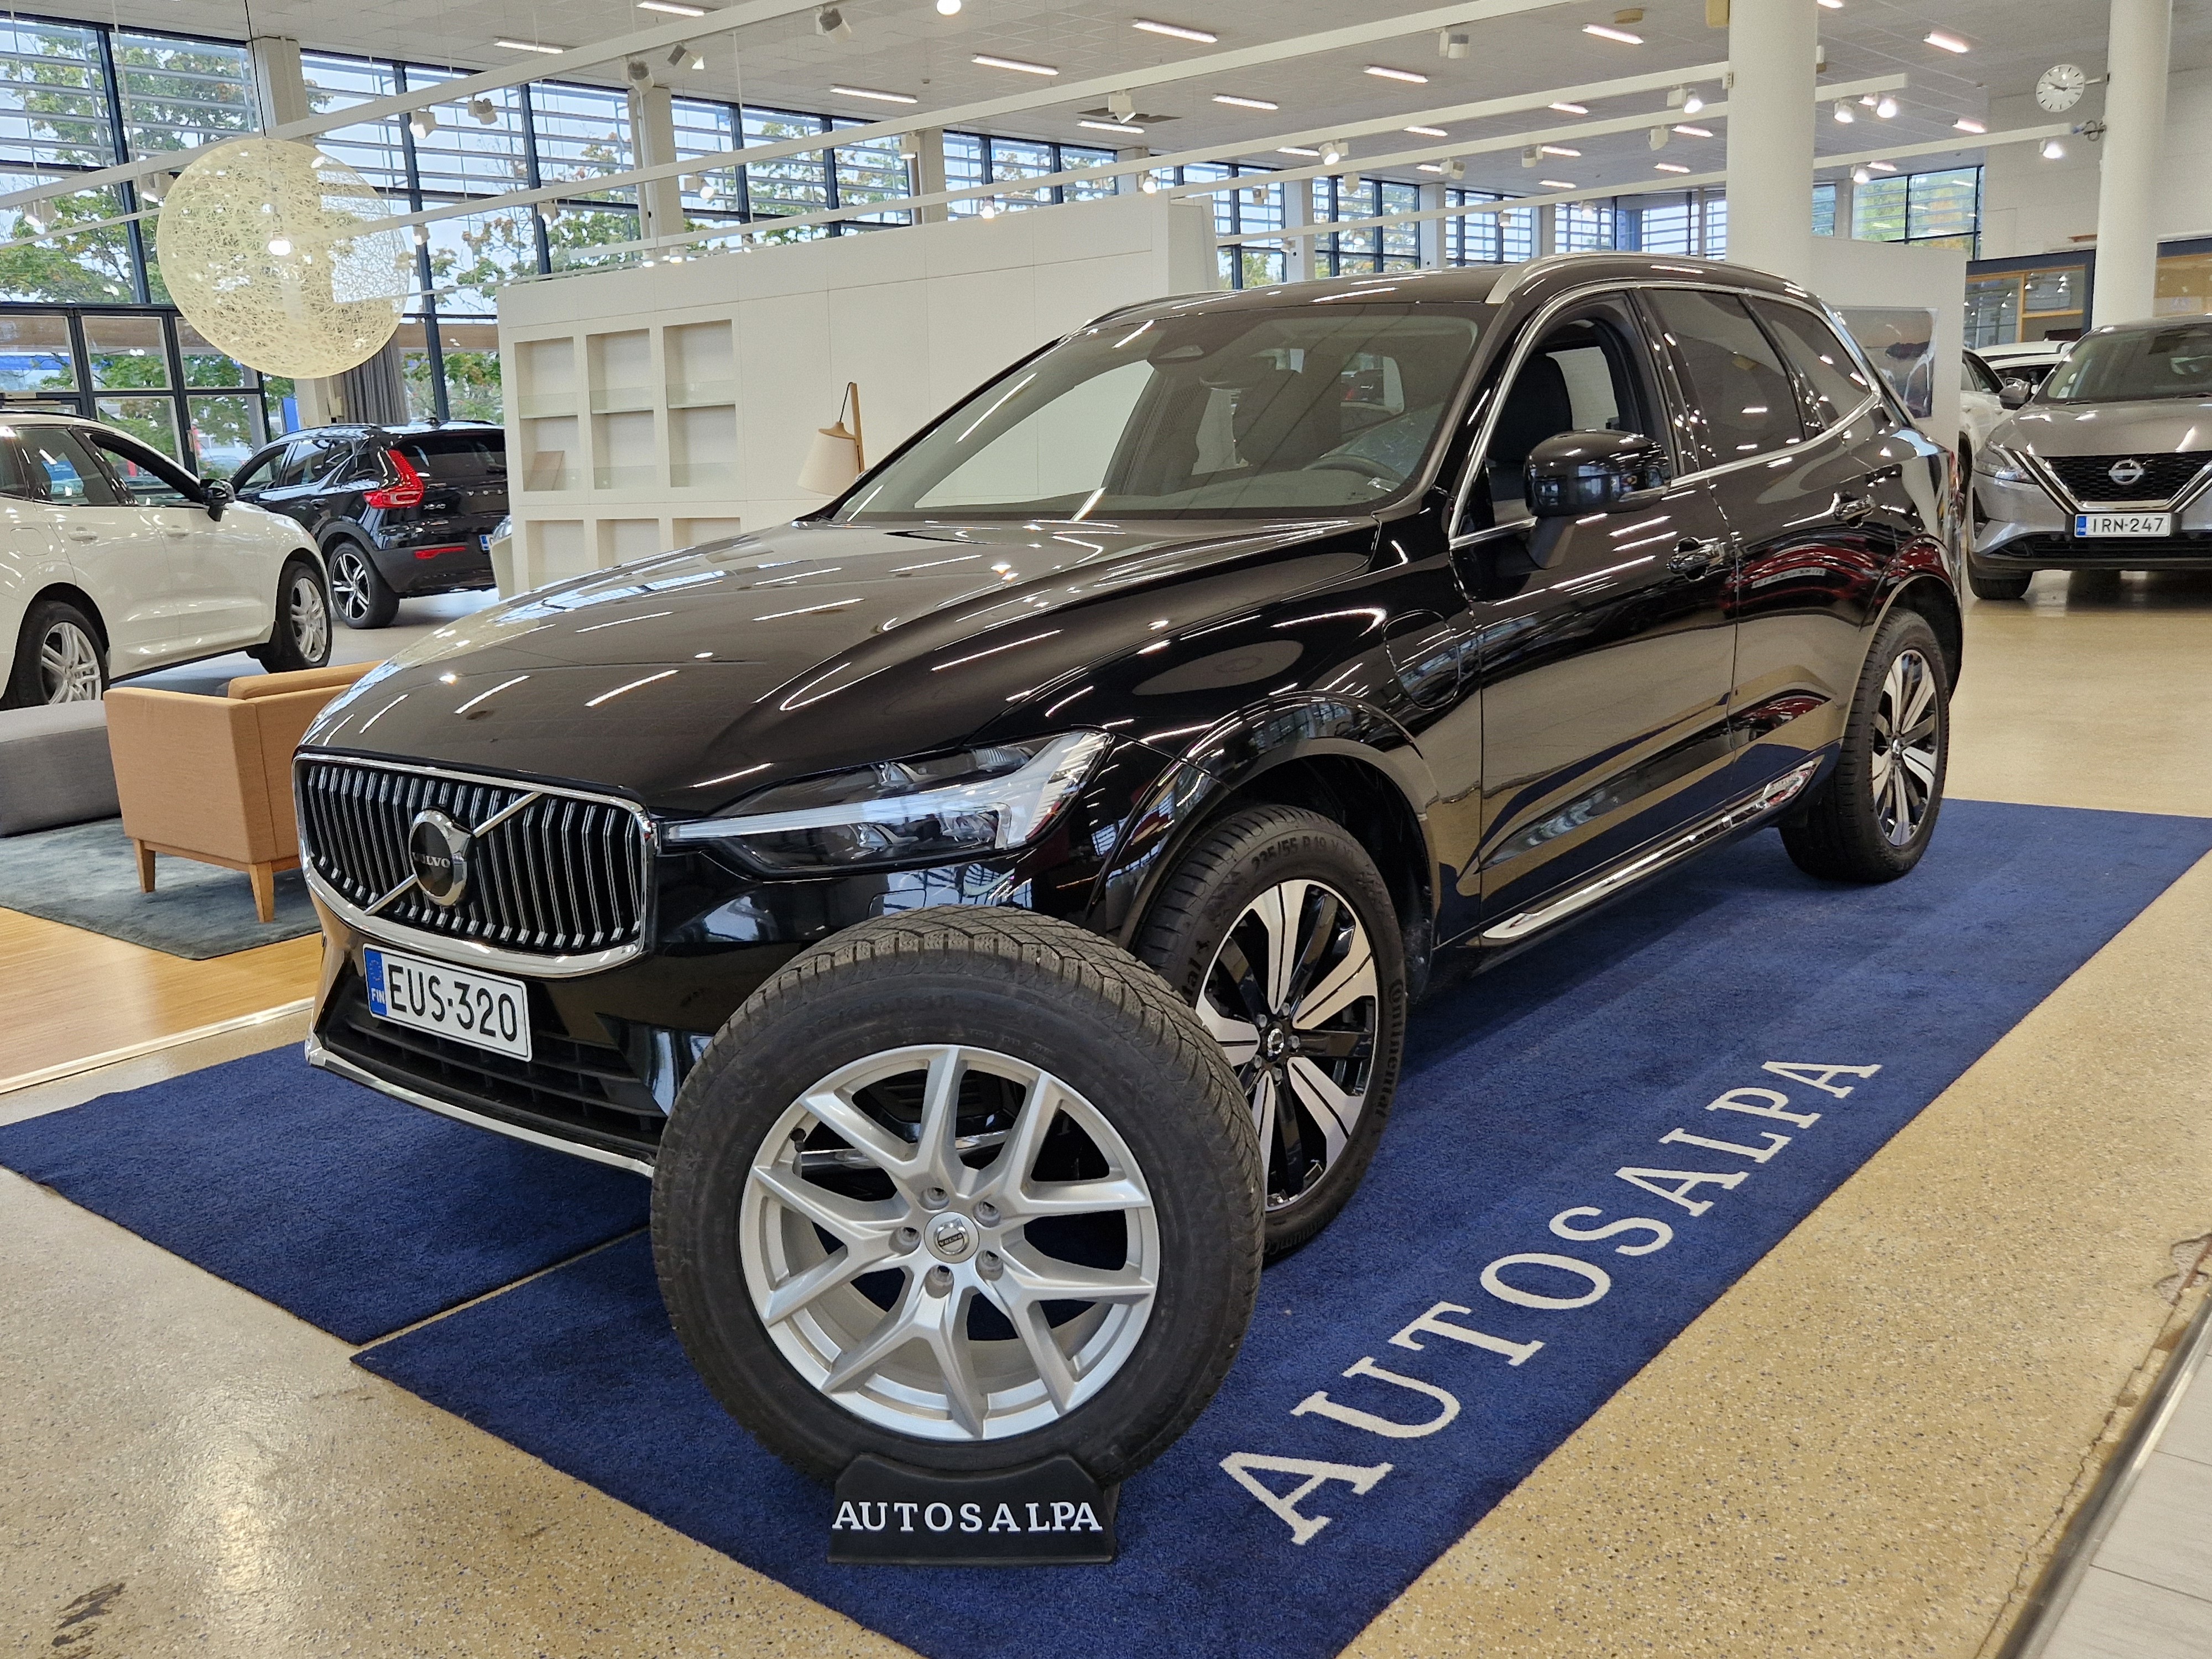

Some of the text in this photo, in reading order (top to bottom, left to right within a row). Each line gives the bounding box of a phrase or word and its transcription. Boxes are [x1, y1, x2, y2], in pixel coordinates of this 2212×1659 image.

[2092, 517, 2164, 533] IRN-247
[371, 988, 385, 1004] FIN
[388, 964, 517, 1041] EUS-320
[1218, 1060, 1883, 1546] AUTOSALPA
[832, 1501, 1103, 1532] AUTOSALPA
